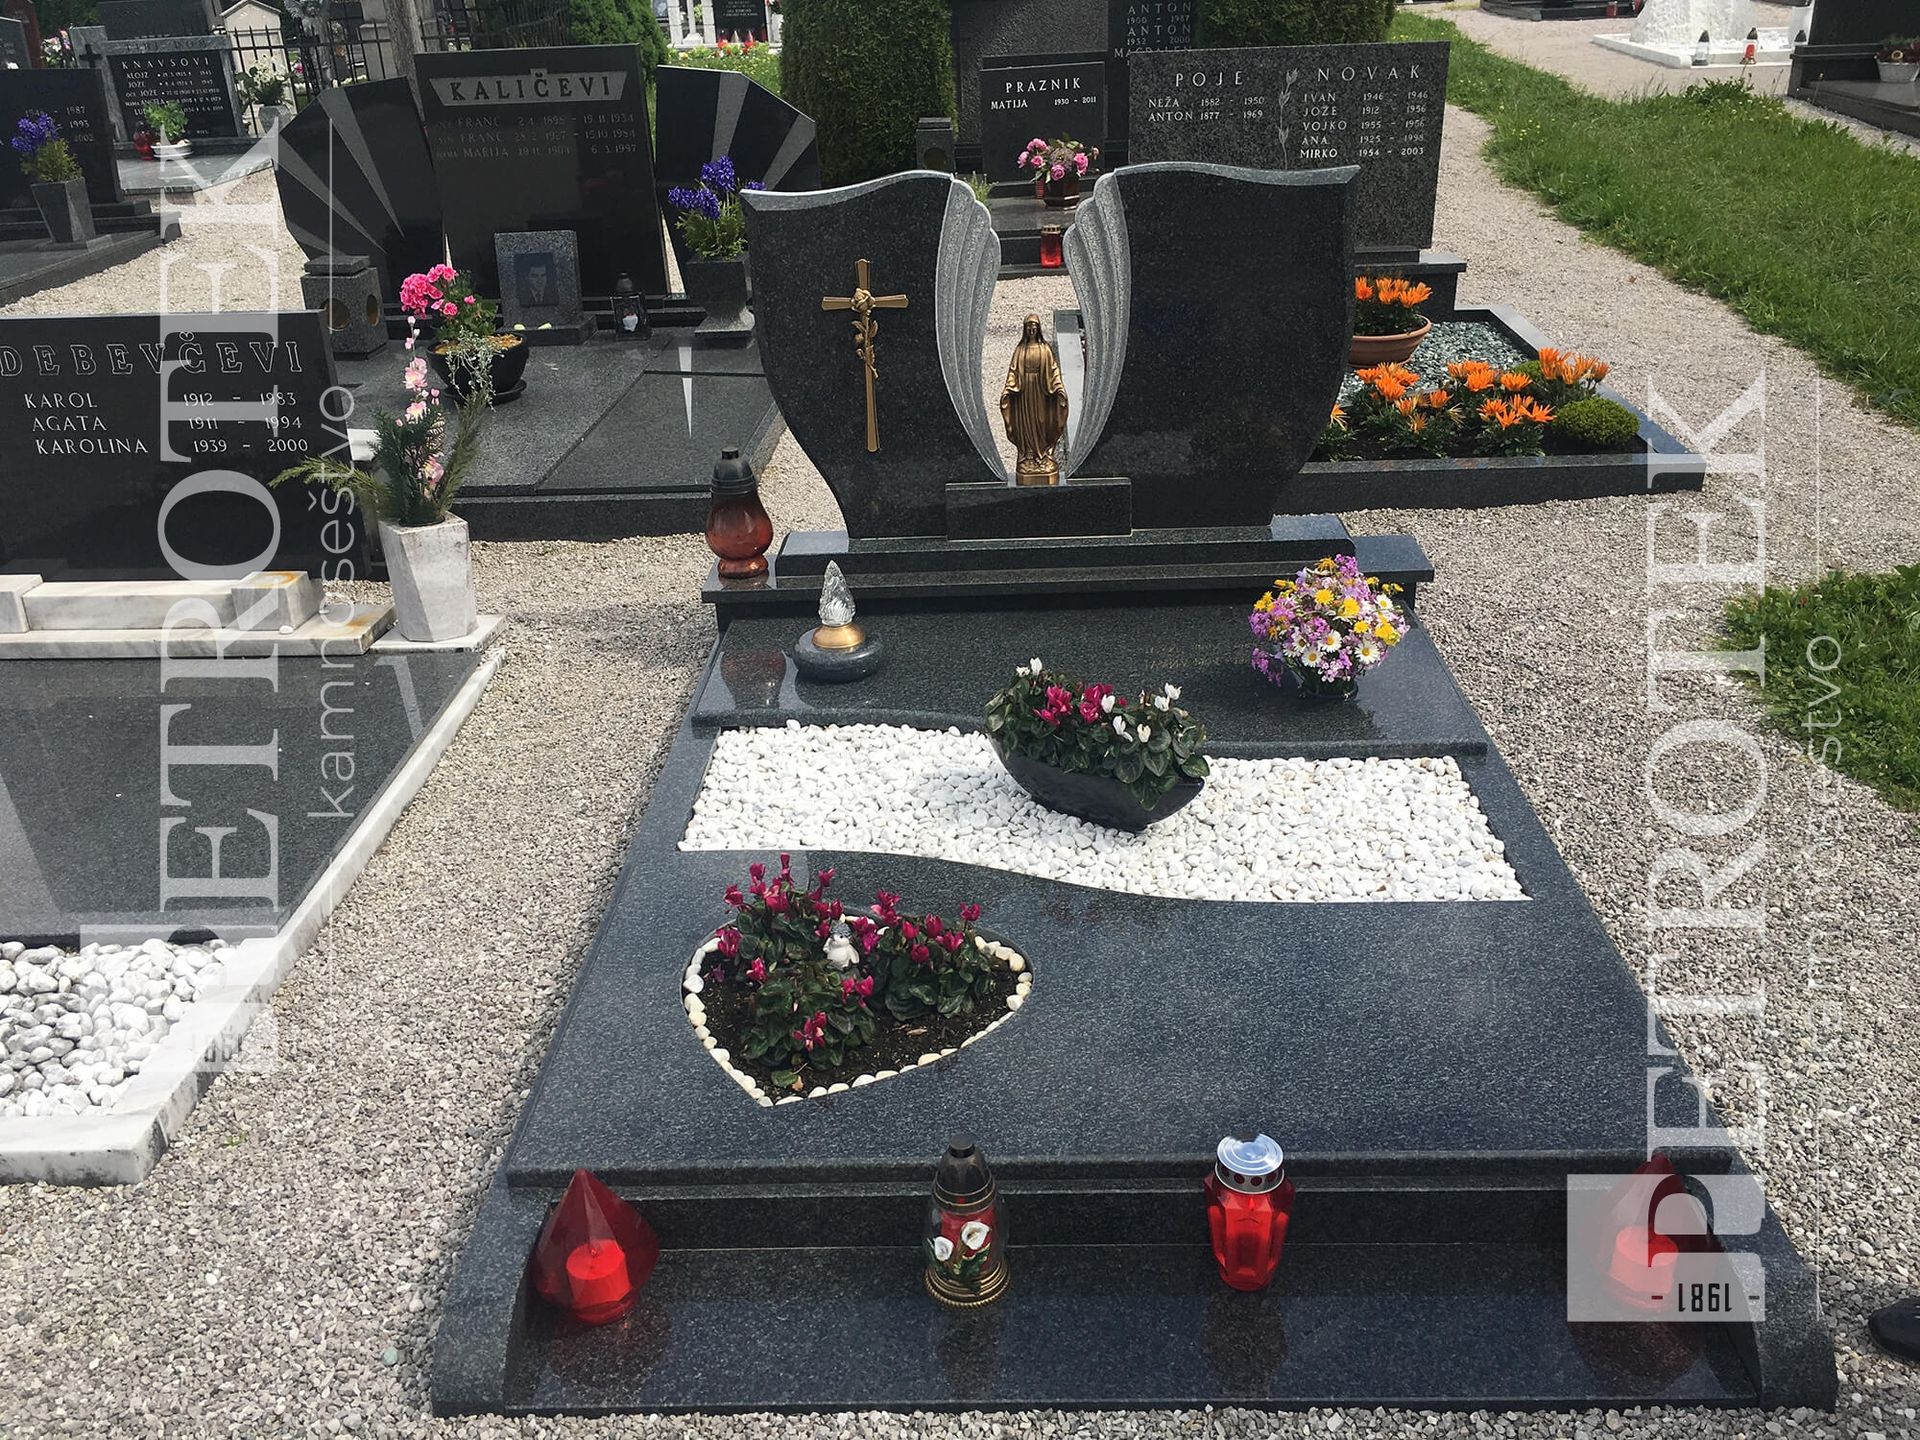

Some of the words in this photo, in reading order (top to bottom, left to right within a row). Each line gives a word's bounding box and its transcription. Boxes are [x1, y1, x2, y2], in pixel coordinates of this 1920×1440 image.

[1127, 2, 1191, 15] ANTON
[1127, 24, 1191, 36] ANTON
[1169, 36, 1190, 44] 2000
[1176, 71, 1244, 87] POJE
[1317, 65, 1420, 82] NOVAK
[450, 72, 610, 101] KALIČEVI
[1005, 77, 1081, 93] PRAZNIK
[1148, 96, 1180, 108] NEŽA
[1244, 96, 1265, 106] 1950
[1304, 92, 1336, 102] IVAN
[1363, 92, 1384, 101] 1946
[1407, 91, 1428, 99] 1946
[990, 99, 1028, 110] MATIJA
[1054, 98, 1070, 106] 1930
[1082, 96, 1097, 104] 2011
[1362, 106, 1379, 114] 1912
[1406, 104, 1426, 113] 1956
[1148, 111, 1193, 122] ANTON
[1200, 111, 1220, 120] 1877
[1243, 110, 1263, 119] 1969
[1303, 121, 1347, 131] VOJKO
[1361, 120, 1381, 129] 1955
[1302, 136, 1328, 146] ANA
[1360, 135, 1381, 143] 1925
[463, 147, 509, 158] MARIJA
[1300, 148, 1338, 158] MIRKO
[1359, 148, 1380, 157] 1954
[1401, 147, 1424, 156] 2003
[0, 330, 303, 377] DEBEVČEVI
[24, 393, 98, 409] KAROL
[183, 393, 214, 406] 1912
[260, 392, 297, 406] 1983
[32, 415, 107, 432] AGATA
[188, 416, 218, 430] 1911
[264, 416, 302, 429] 1994
[36, 438, 149, 455] KAROLINA
[193, 439, 228, 453] 1939
[267, 438, 309, 452] 2000
